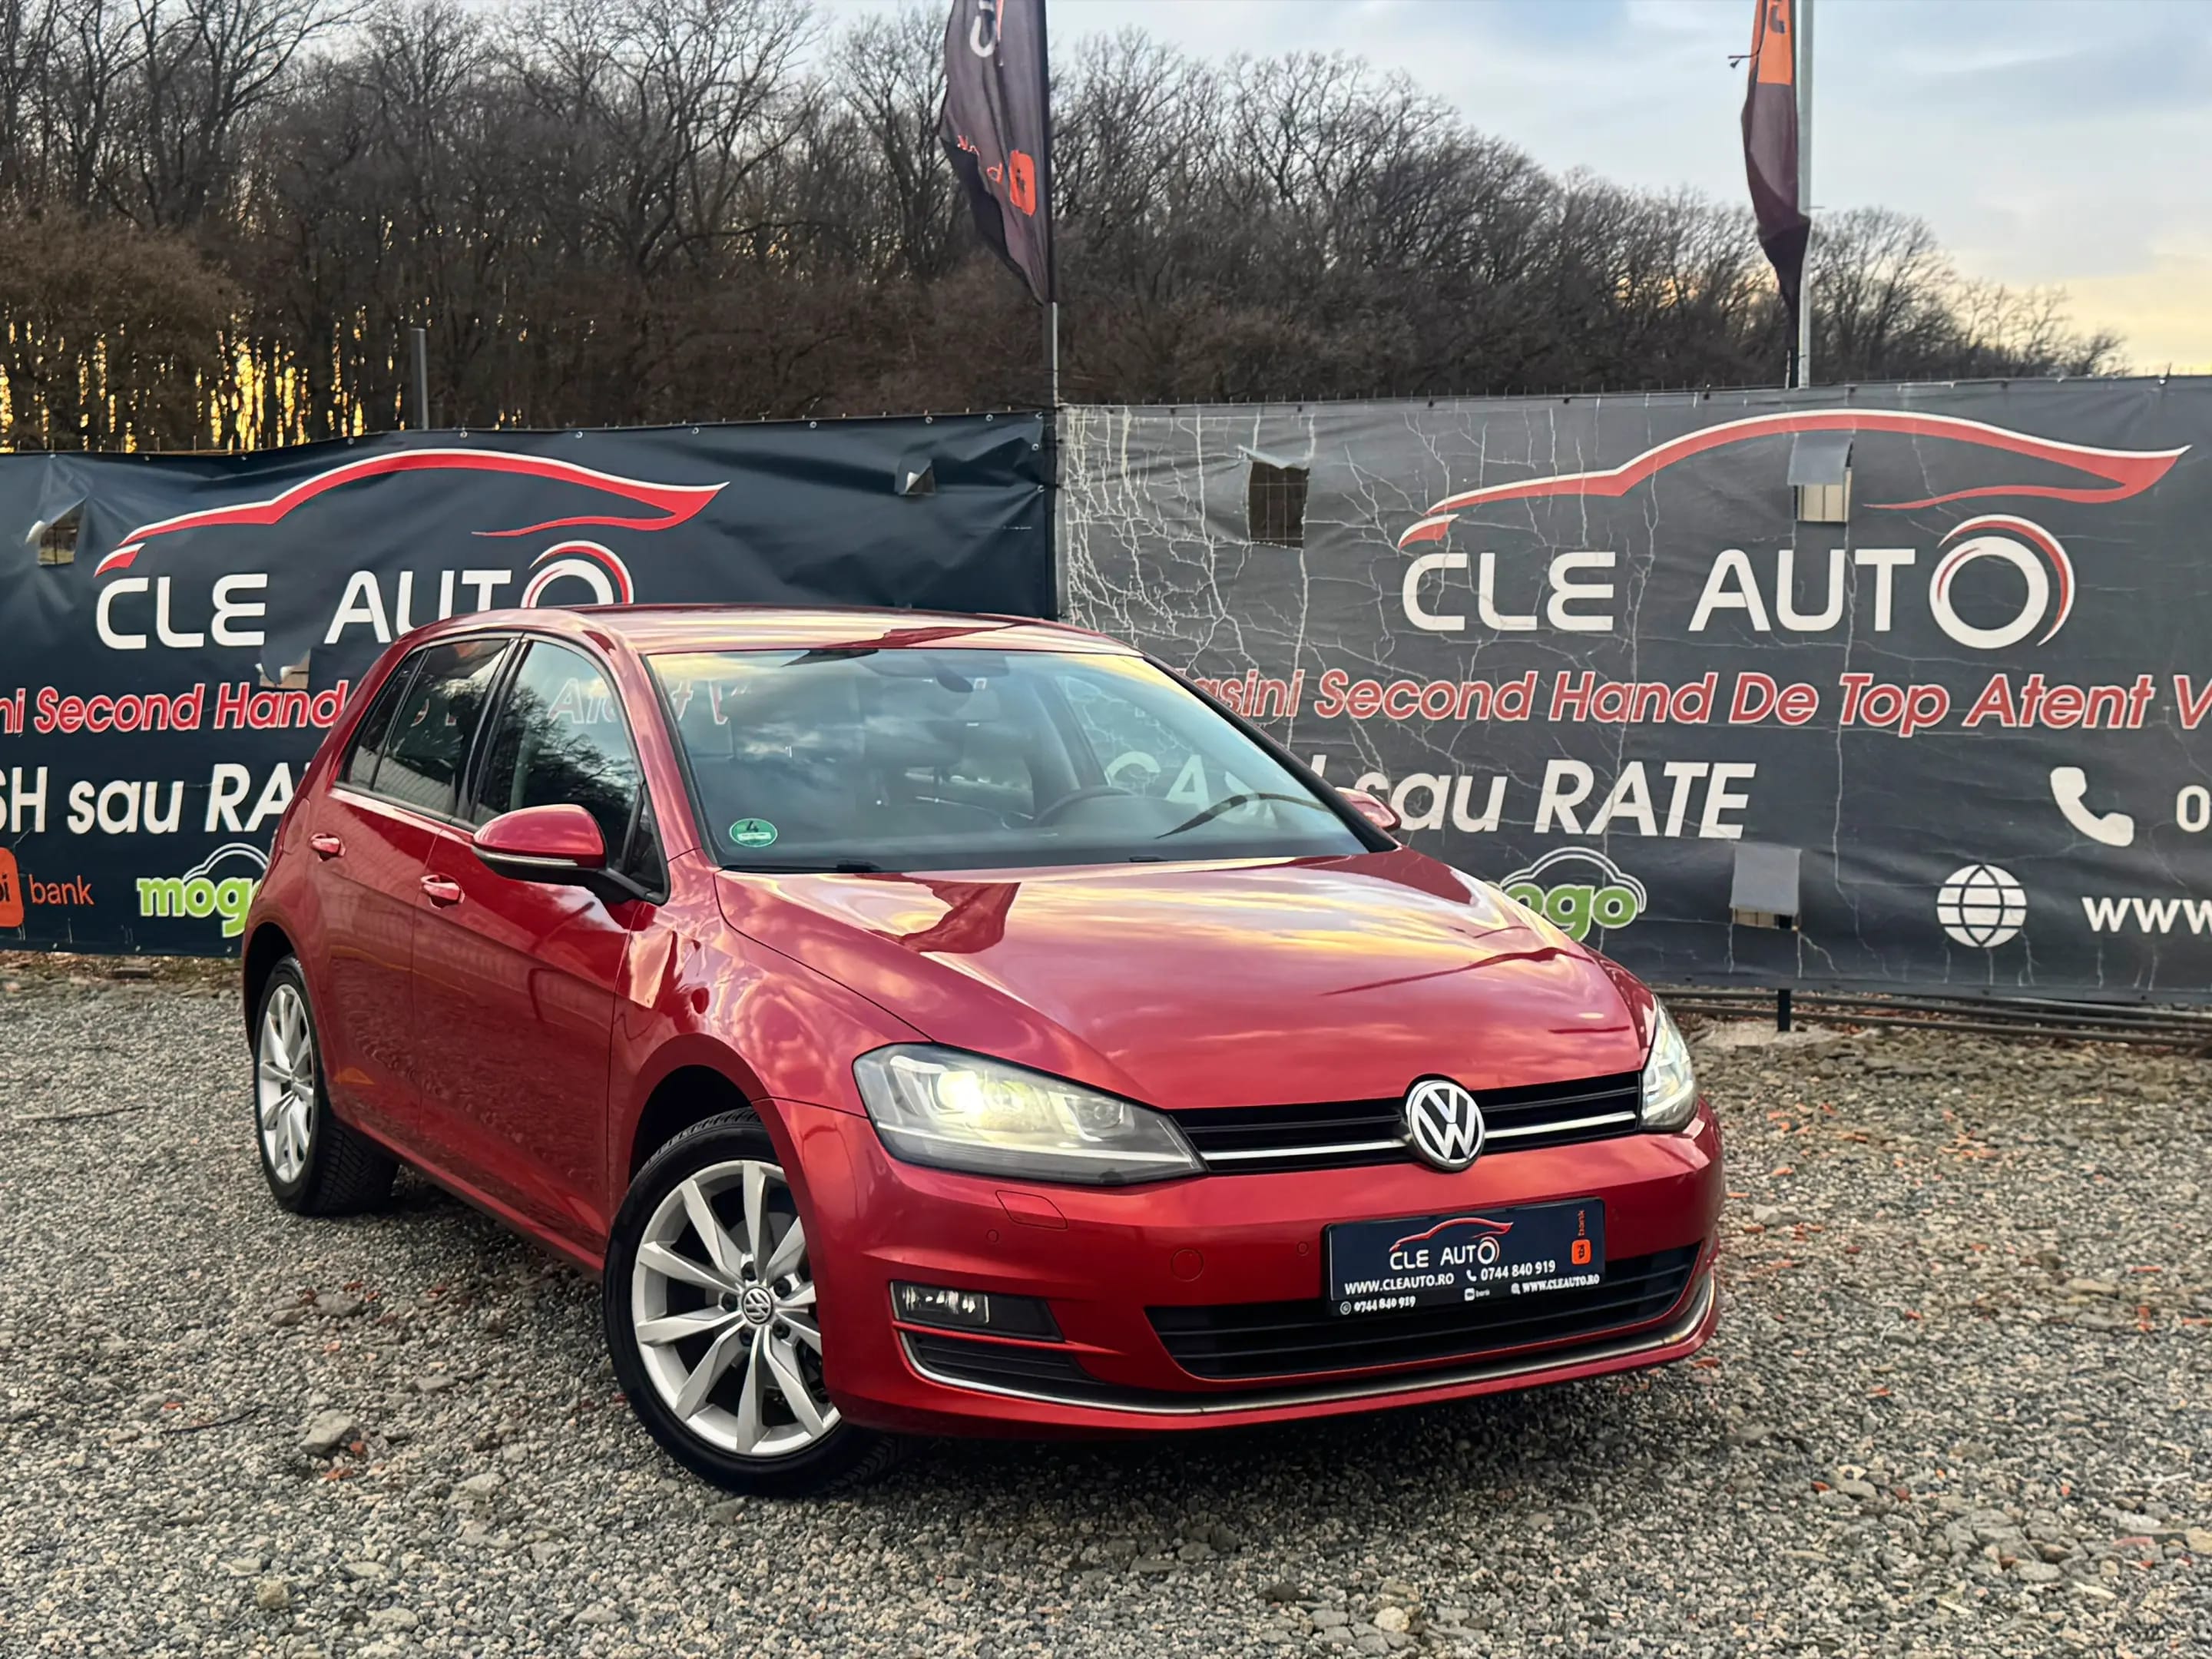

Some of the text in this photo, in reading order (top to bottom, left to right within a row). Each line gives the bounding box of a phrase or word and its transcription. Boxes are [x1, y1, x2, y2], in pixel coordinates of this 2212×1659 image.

[96, 572, 268, 650] CLE
[1402, 536, 2050, 649] CLE AUTO
[34, 685, 206, 733] Second
[214, 680, 349, 730] Hand
[1313, 668, 1539, 720] Second
[1548, 671, 1719, 724] Hand
[1728, 672, 1820, 725] De
[1839, 673, 1950, 738] Top
[1962, 673, 2156, 730] Atent
[67, 780, 184, 835] sau
[1535, 759, 1757, 840] RATE
[28, 873, 95, 905] bank
[135, 876, 263, 939] mog
[1485, 882, 1639, 942] ogo
[1389, 1240, 1496, 1270] CLE AUTO
[1480, 1259, 1556, 1282] 0744 840 919
[1344, 1272, 1455, 1296] WWW.CLEAUTO.RO
